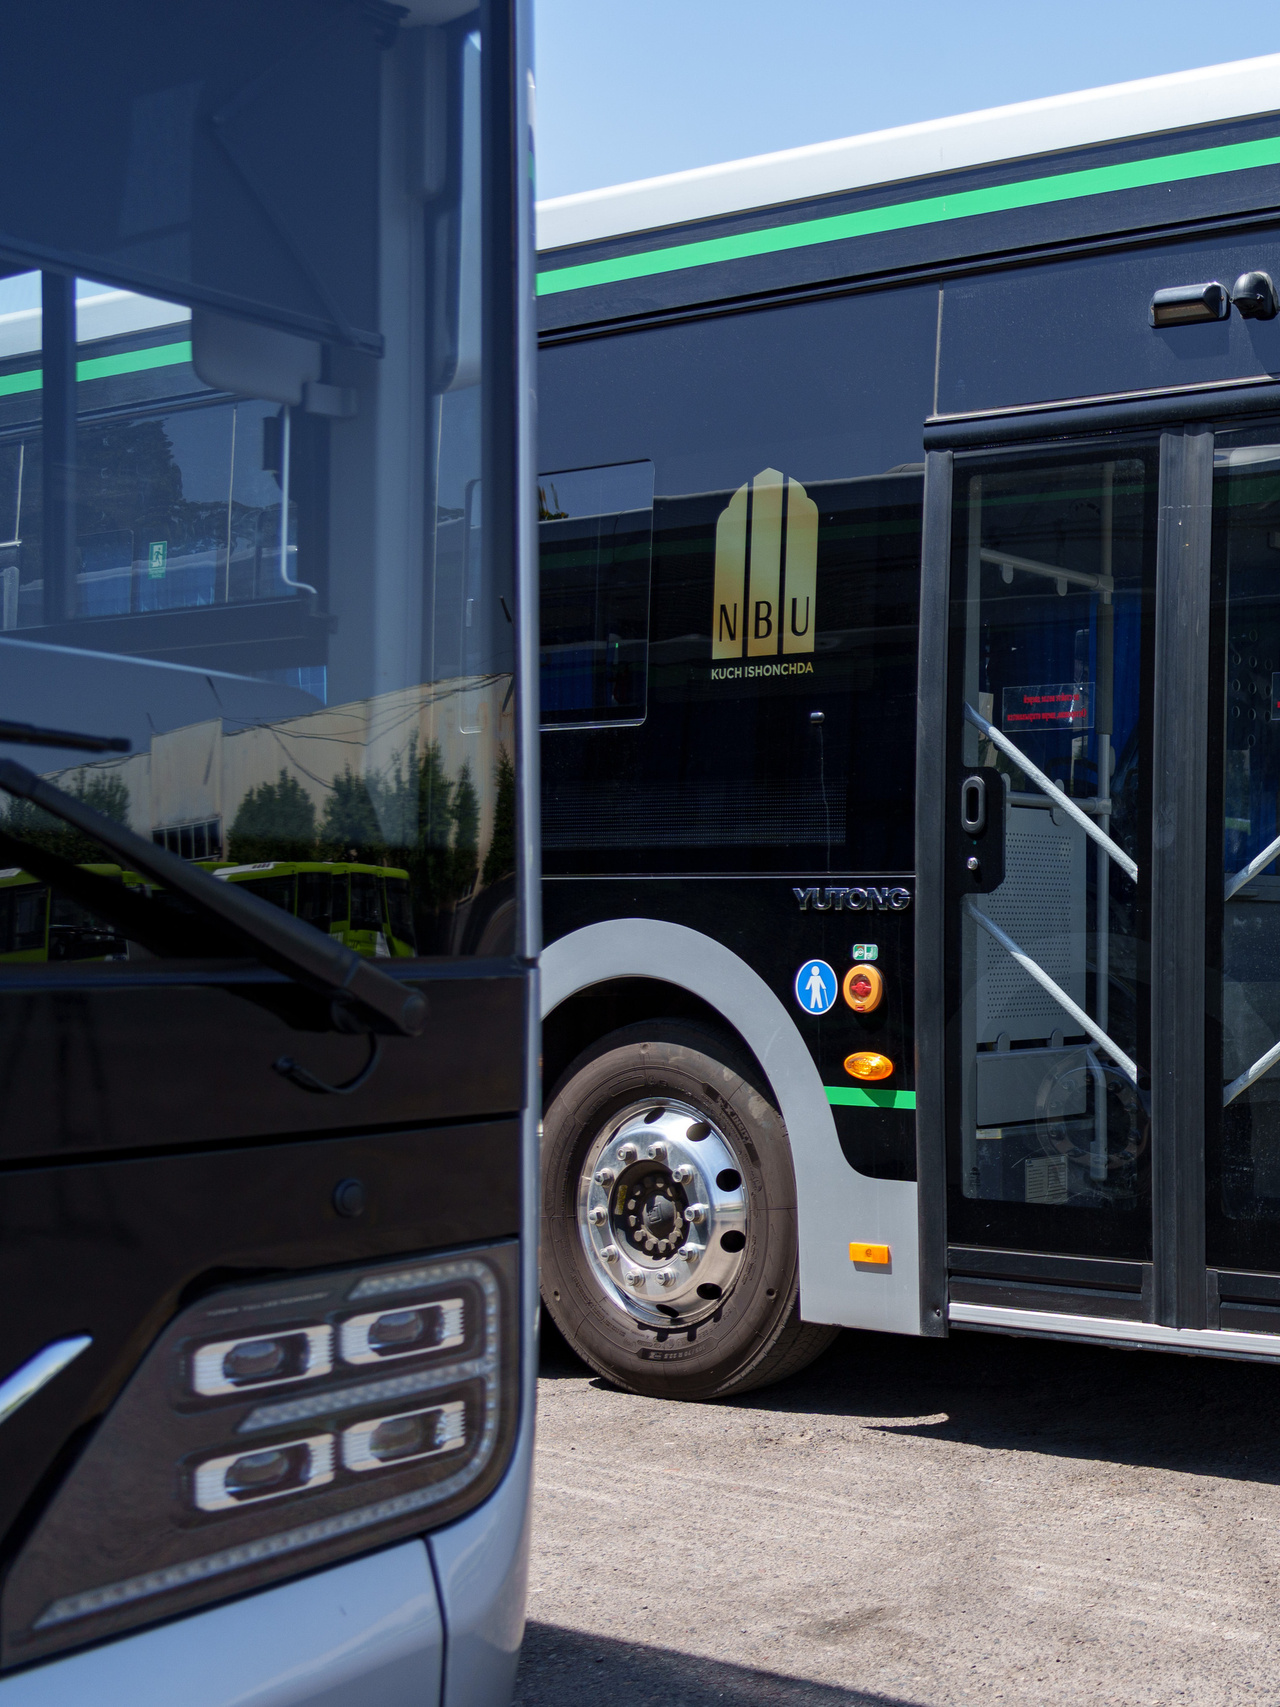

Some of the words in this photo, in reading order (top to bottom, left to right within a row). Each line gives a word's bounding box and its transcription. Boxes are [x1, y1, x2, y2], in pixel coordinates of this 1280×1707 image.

[718, 596, 811, 643] NBU
[710, 667, 743, 680] KUCH
[744, 662, 815, 678] ISHONCHDA
[791, 885, 911, 910] YUTONG
